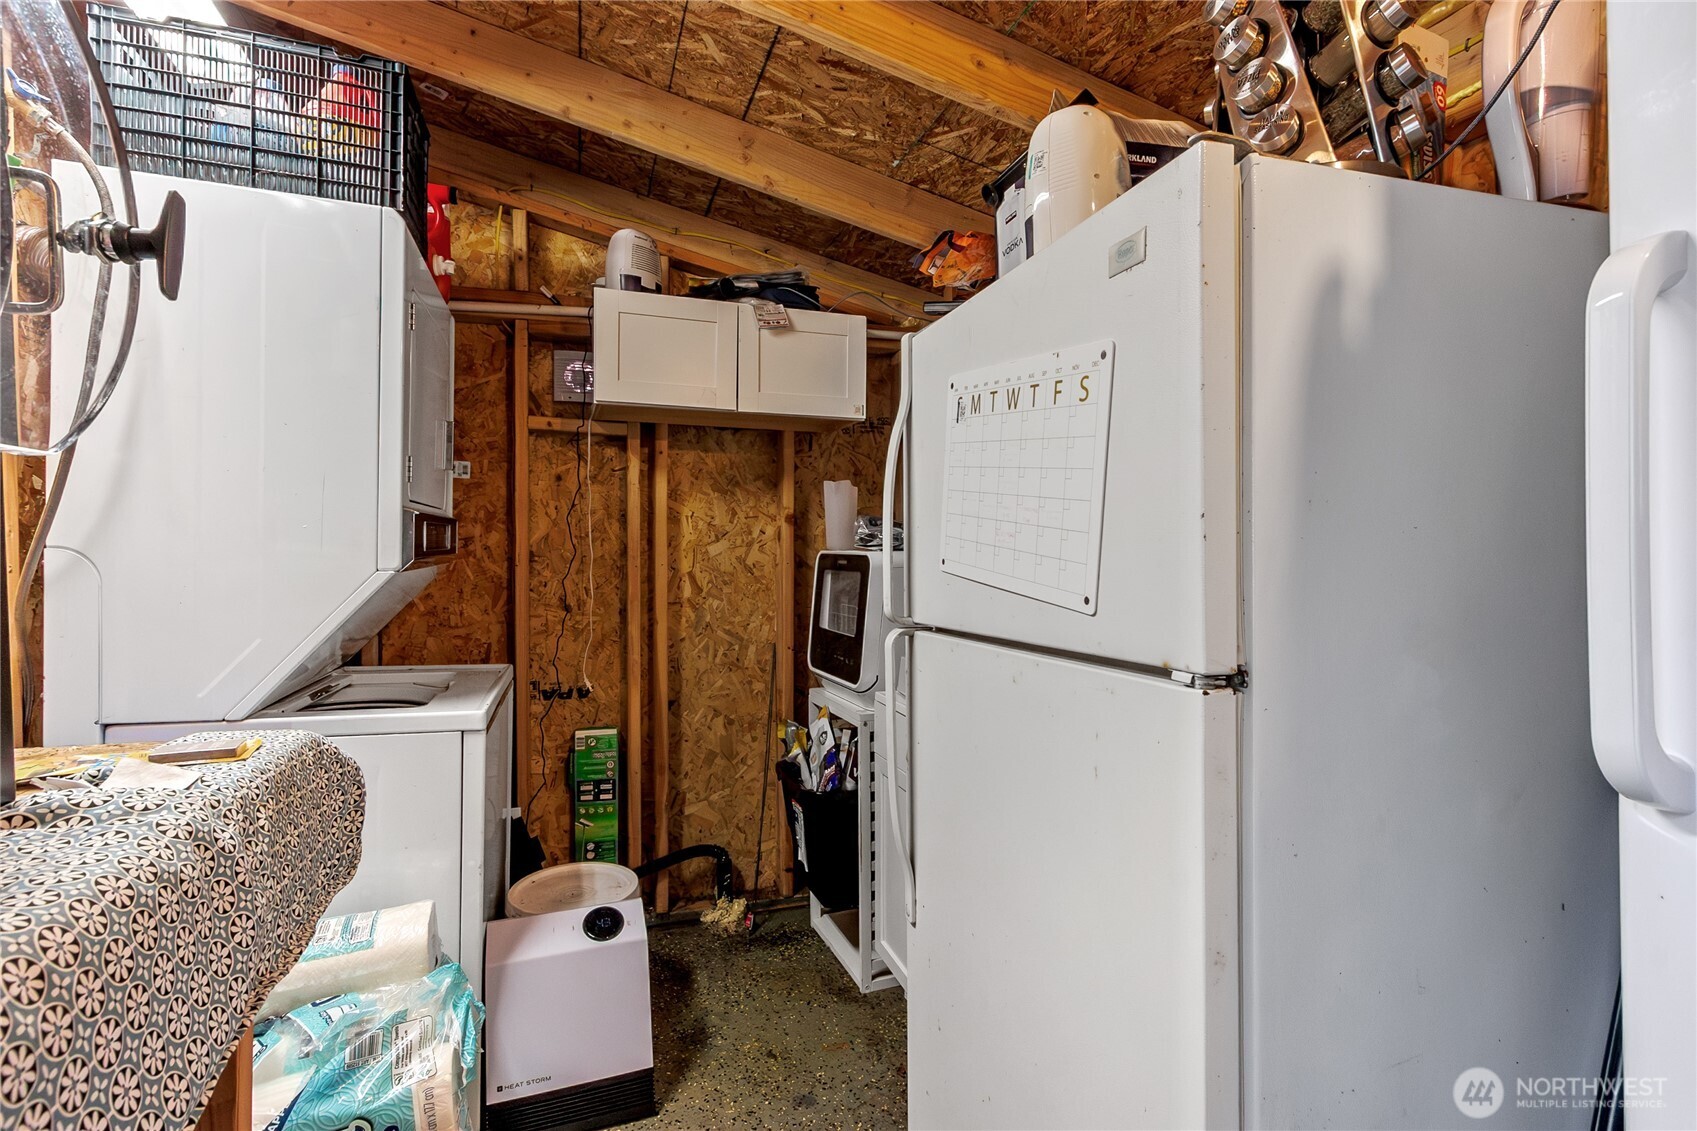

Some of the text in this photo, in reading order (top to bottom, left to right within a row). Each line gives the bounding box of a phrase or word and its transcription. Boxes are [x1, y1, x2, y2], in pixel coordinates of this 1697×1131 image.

[1236, 71, 1261, 89] PIZZA
[1127, 154, 1157, 164] RKLAND
[1001, 237, 1024, 257] VODKA
[970, 393, 982, 415] M
[990, 391, 998, 413] T
[1006, 386, 1021, 410] W
[1029, 383, 1040, 407] T
[1053, 379, 1063, 405] F
[1078, 375, 1090, 403] S
[504, 1075, 552, 1092] HEAT STORM
